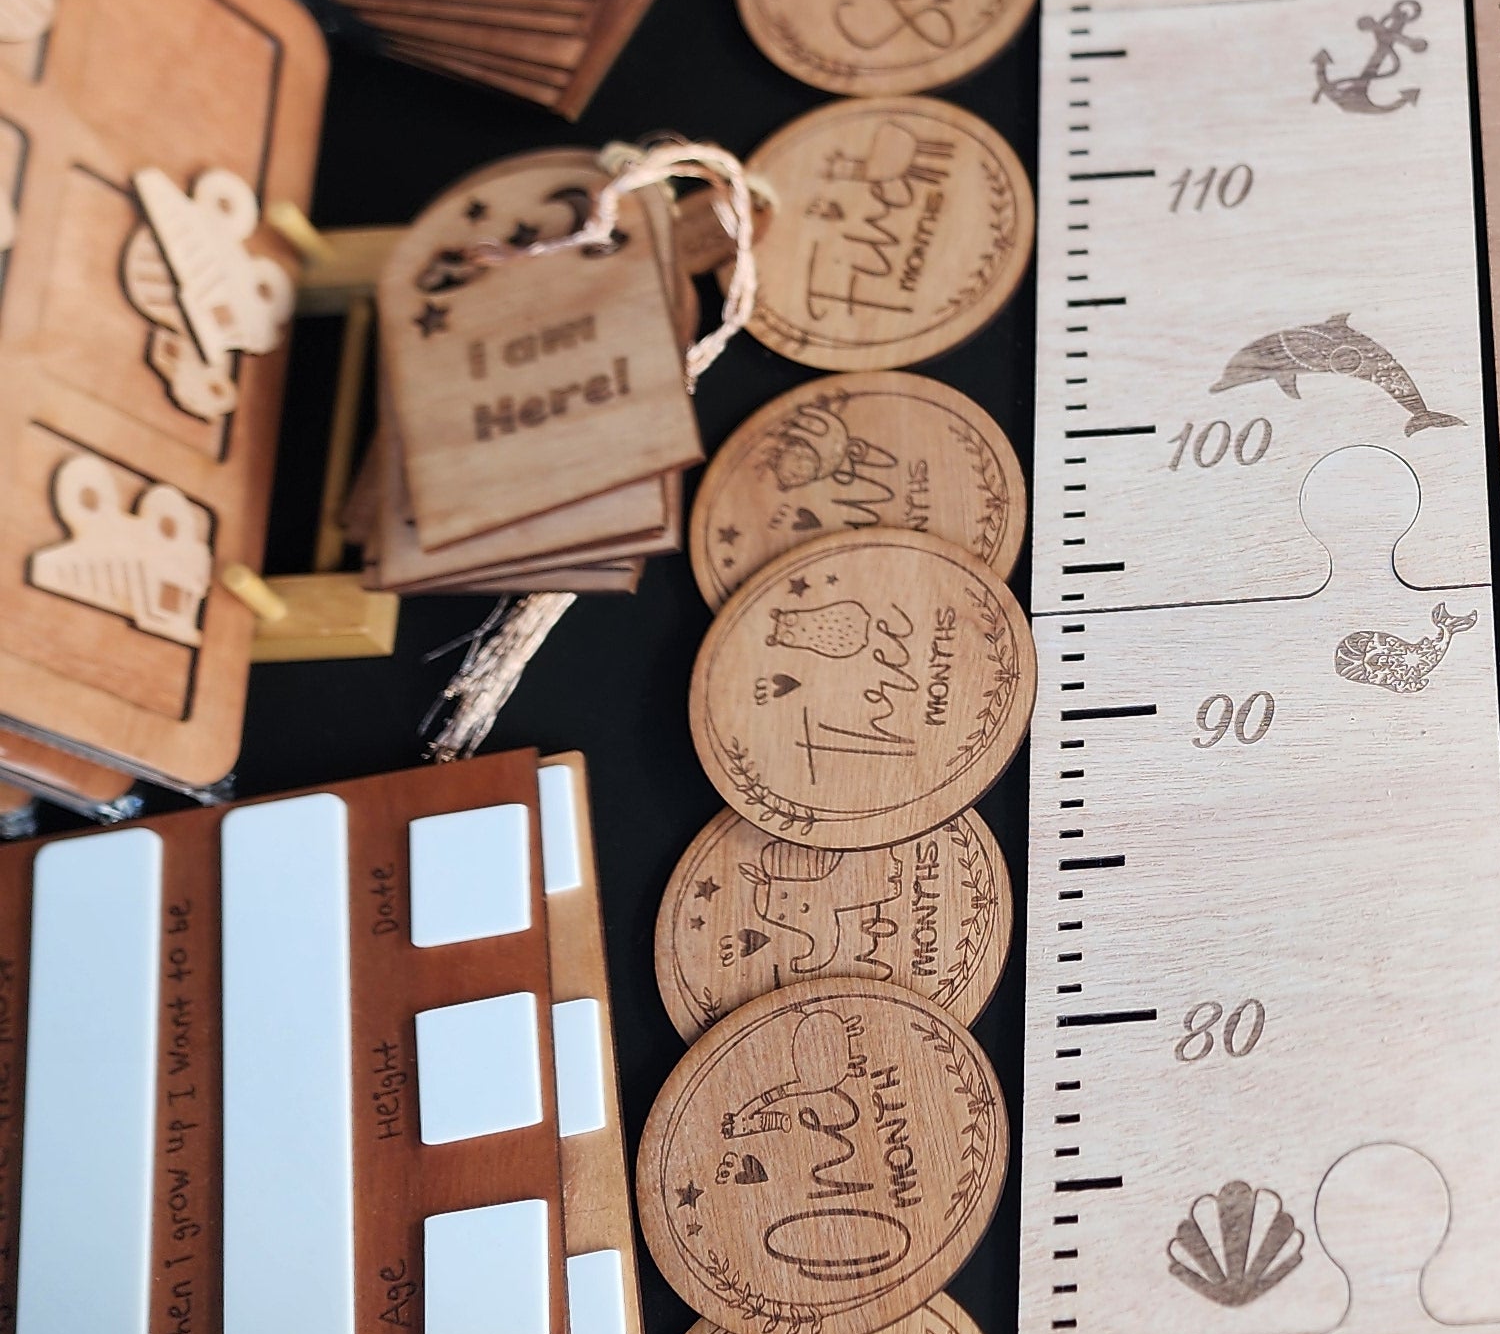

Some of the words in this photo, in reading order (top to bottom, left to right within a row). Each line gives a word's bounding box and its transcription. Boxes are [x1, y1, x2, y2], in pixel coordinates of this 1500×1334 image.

[1168, 164, 1254, 213] 110
[806, 179, 914, 321] Five
[901, 192, 944, 292] MONTHS
[467, 340, 487, 380] I
[502, 315, 596, 369] am
[475, 356, 632, 443] Here!
[1167, 418, 1272, 471] 100
[902, 460, 929, 532] NTHS
[795, 603, 919, 785] Three
[925, 606, 956, 726] MONTHS
[1192, 691, 1275, 749] 90
[167, 900, 193, 934] be
[371, 863, 398, 937] Date
[911, 840, 940, 977] MONTHS
[168, 948, 193, 983] to
[1174, 998, 1266, 1061] 80
[169, 1083, 195, 1102] I
[371, 1041, 405, 1142] Height
[168, 1120, 198, 1153] up
[871, 1065, 922, 1209] MONTH
[167, 1168, 201, 1241] grow
[765, 1086, 912, 1281] One
[379, 1258, 417, 1327] Age
